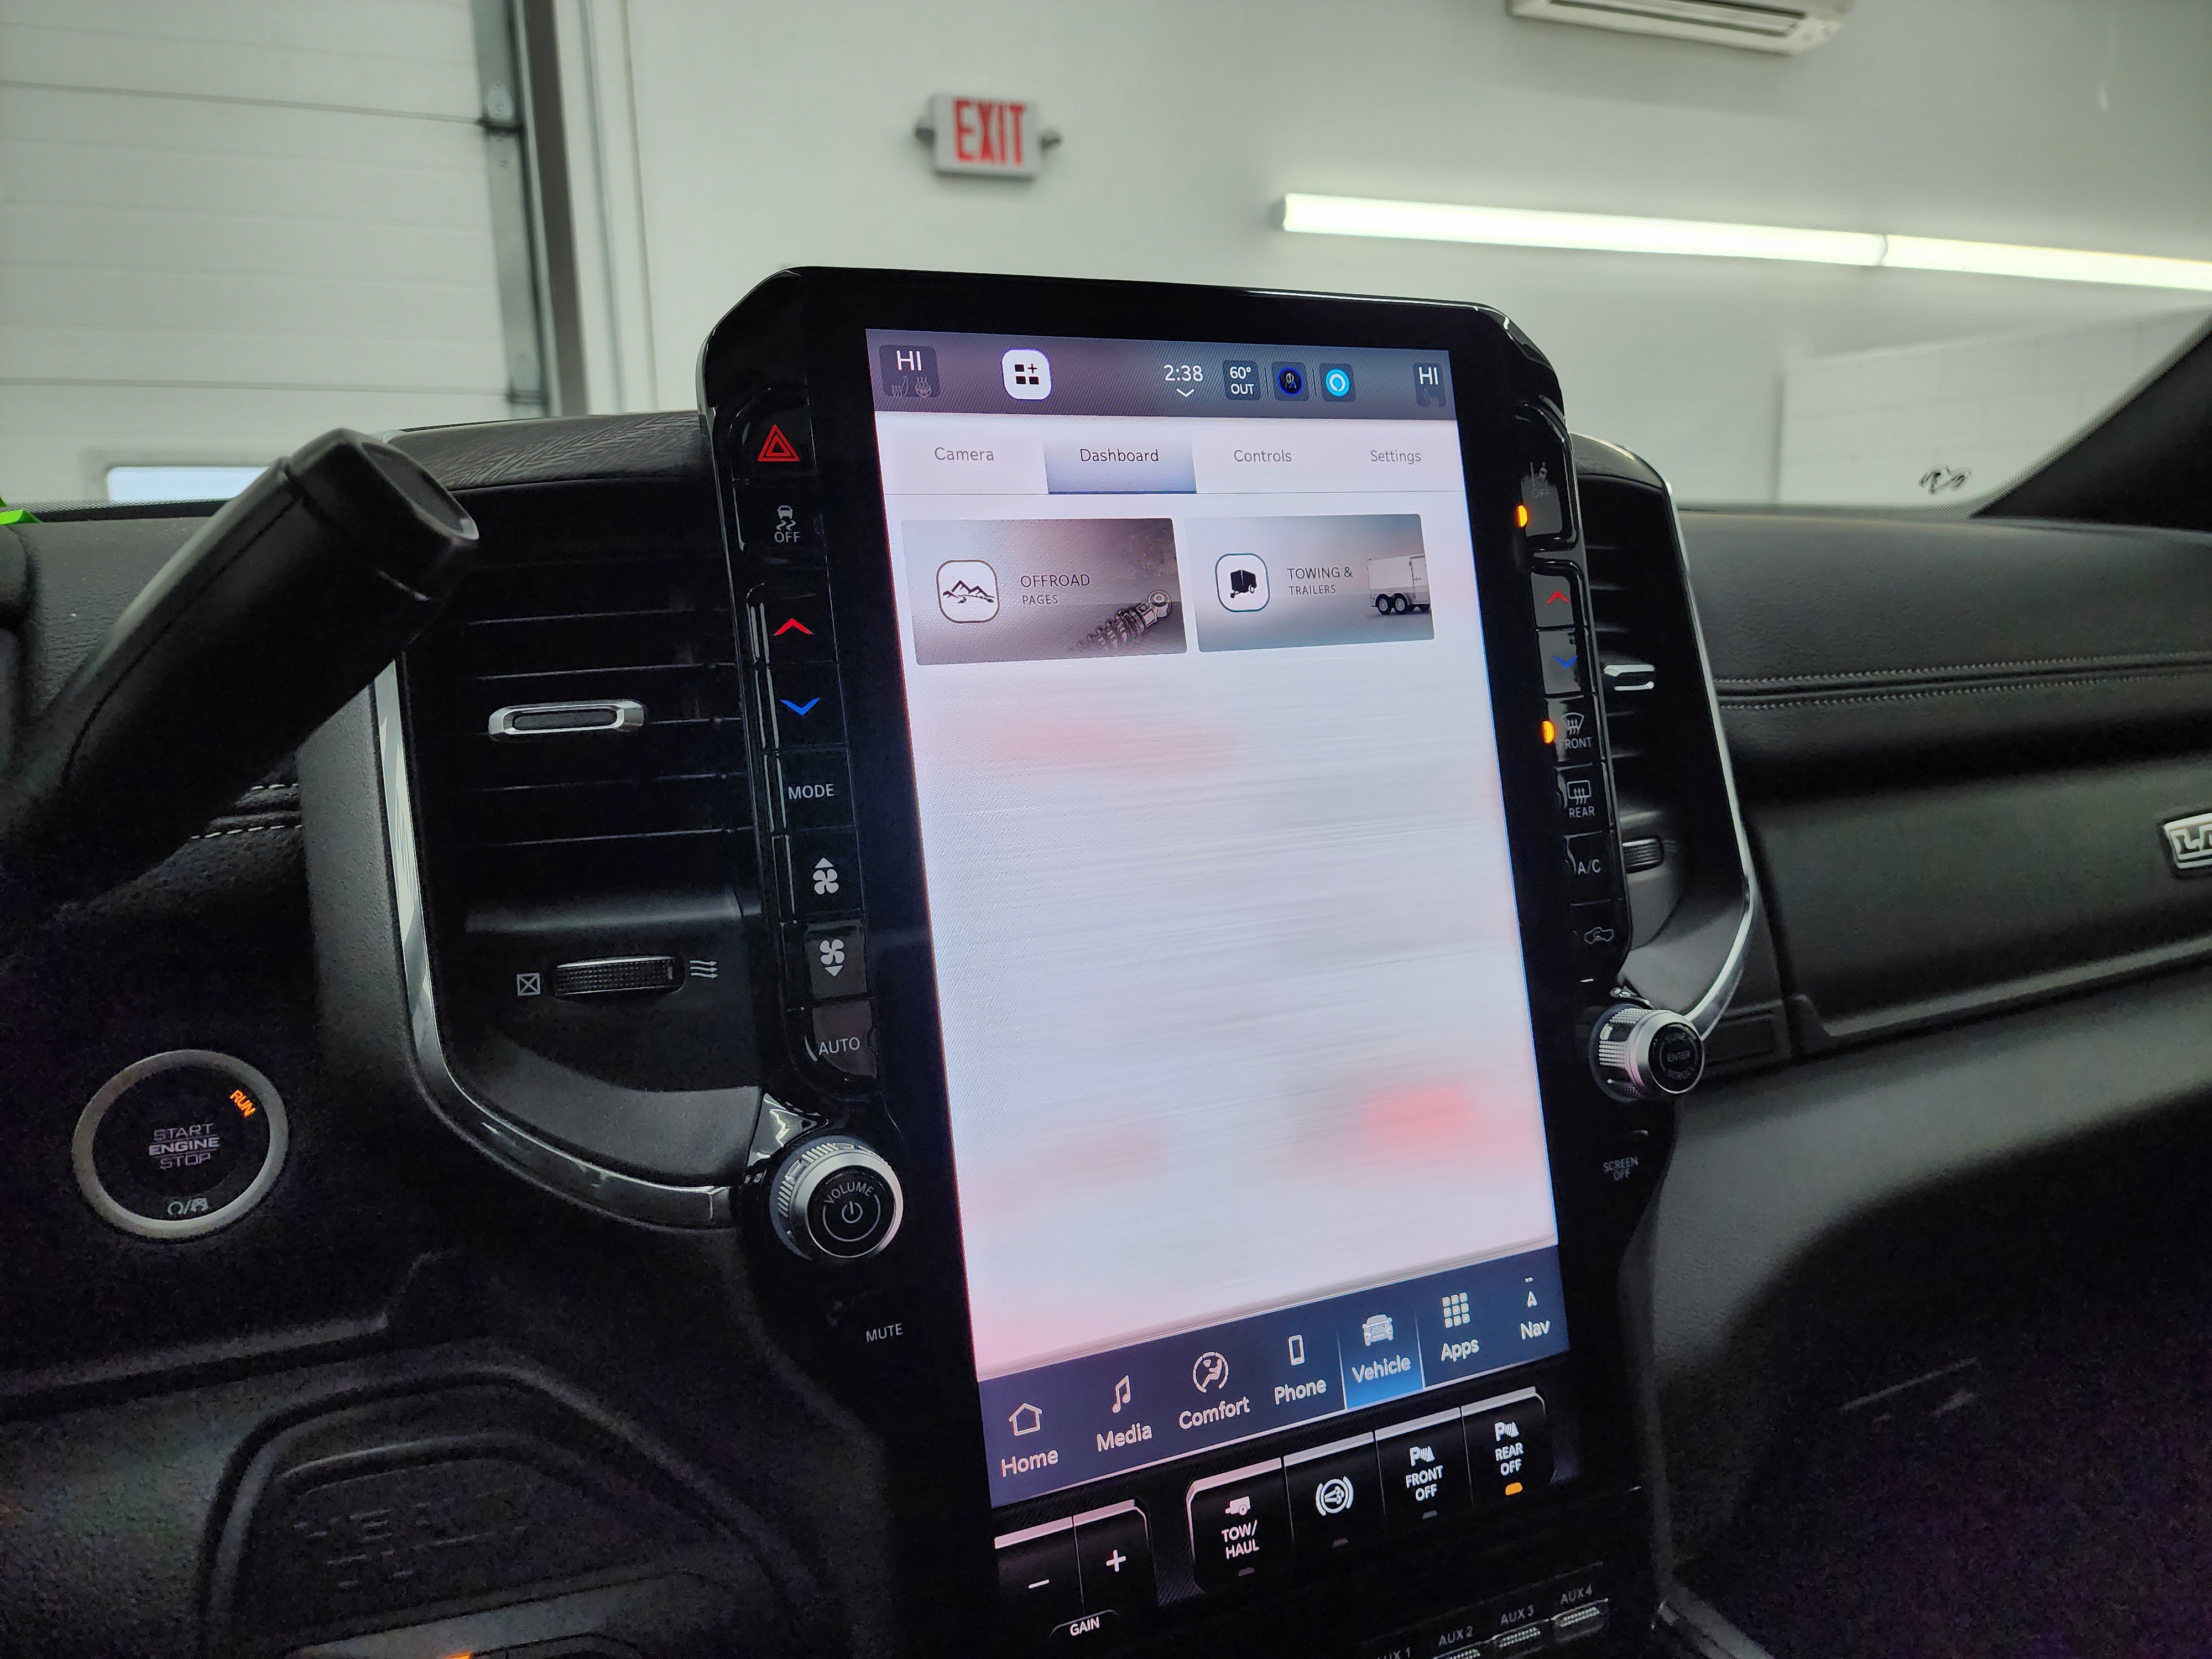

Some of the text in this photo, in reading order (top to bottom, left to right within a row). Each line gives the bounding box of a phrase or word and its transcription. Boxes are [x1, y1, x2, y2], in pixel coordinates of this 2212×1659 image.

[953, 97, 1026, 166] EXIT
[896, 350, 922, 371] HI
[1164, 364, 1203, 382] 2:38
[1418, 367, 1438, 385] HI
[1230, 383, 1254, 395] OUT
[934, 447, 994, 461] Camera
[1080, 448, 1159, 462] Dashboard
[1234, 450, 1292, 463] Controls
[1370, 450, 1421, 465] Settings
[775, 531, 800, 542] OFF
[1020, 574, 1090, 588] OFFROAD
[1287, 566, 1353, 580] TOWING &
[1289, 584, 1336, 596] TRAILERS
[1022, 594, 1058, 606] PAGES
[1559, 737, 1592, 749] FRONT
[788, 784, 834, 800] MODE
[1569, 807, 1595, 818] REAR
[1578, 859, 1601, 875] A/C
[818, 1037, 860, 1056] AUTO
[229, 1089, 256, 1118] RUN
[154, 1123, 215, 1141] START
[149, 1137, 220, 1156] ENGINE
[159, 1152, 211, 1169] STOP
[825, 1181, 875, 1204] VOLUME
[866, 1323, 904, 1342] MUTE
[1520, 1319, 1551, 1340] Nav
[1441, 1339, 1480, 1362] Apps
[1352, 1355, 1411, 1384] Vehicle
[1274, 1379, 1327, 1405] Phone
[1179, 1396, 1250, 1430] Comfort
[1096, 1423, 1152, 1452] Media
[1495, 1443, 1524, 1461] REAR
[1000, 1449, 1060, 1478] Home
[1500, 1459, 1522, 1476] OFF
[1406, 1465, 1443, 1488] FRONT
[1415, 1484, 1438, 1502] OFF
[1222, 1520, 1258, 1543] TOW/
[1226, 1539, 1260, 1559] HAUL
[1559, 1590, 1583, 1605] AUX
[1070, 1616, 1100, 1636] GAIN
[1500, 1610, 1525, 1626] AUX
[1438, 1625, 1474, 1647] AUX 2
